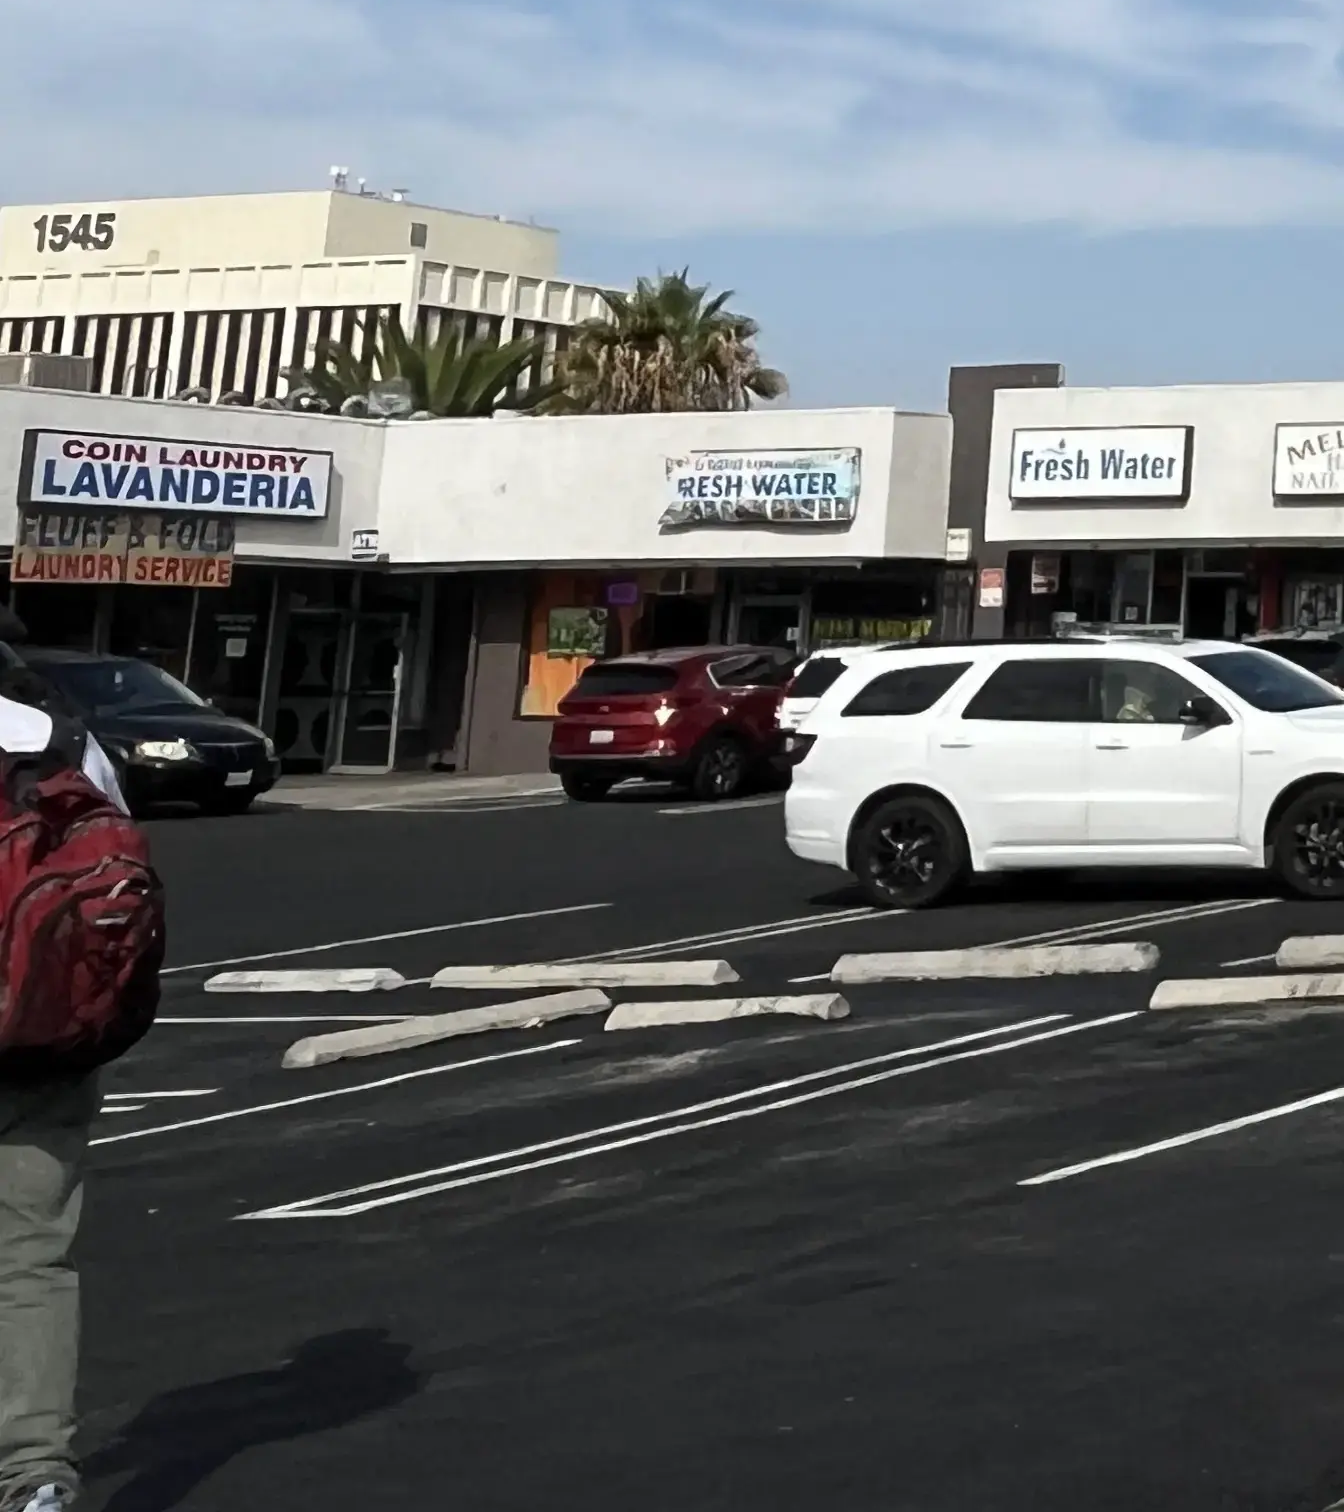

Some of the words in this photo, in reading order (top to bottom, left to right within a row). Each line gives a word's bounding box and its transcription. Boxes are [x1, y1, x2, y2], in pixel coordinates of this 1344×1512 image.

[33, 213, 117, 253] 1545
[62, 440, 147, 463] COIN
[159, 447, 308, 473] LAUNDRY
[1020, 449, 1090, 482] Fresh
[1100, 449, 1176, 479] Water
[42, 459, 316, 510] LAVANDERIA
[751, 472, 838, 497] WATER
[160, 516, 235, 552] FOLD
[14, 553, 127, 582] LAUNDRY
[135, 556, 231, 584] SERVICE
